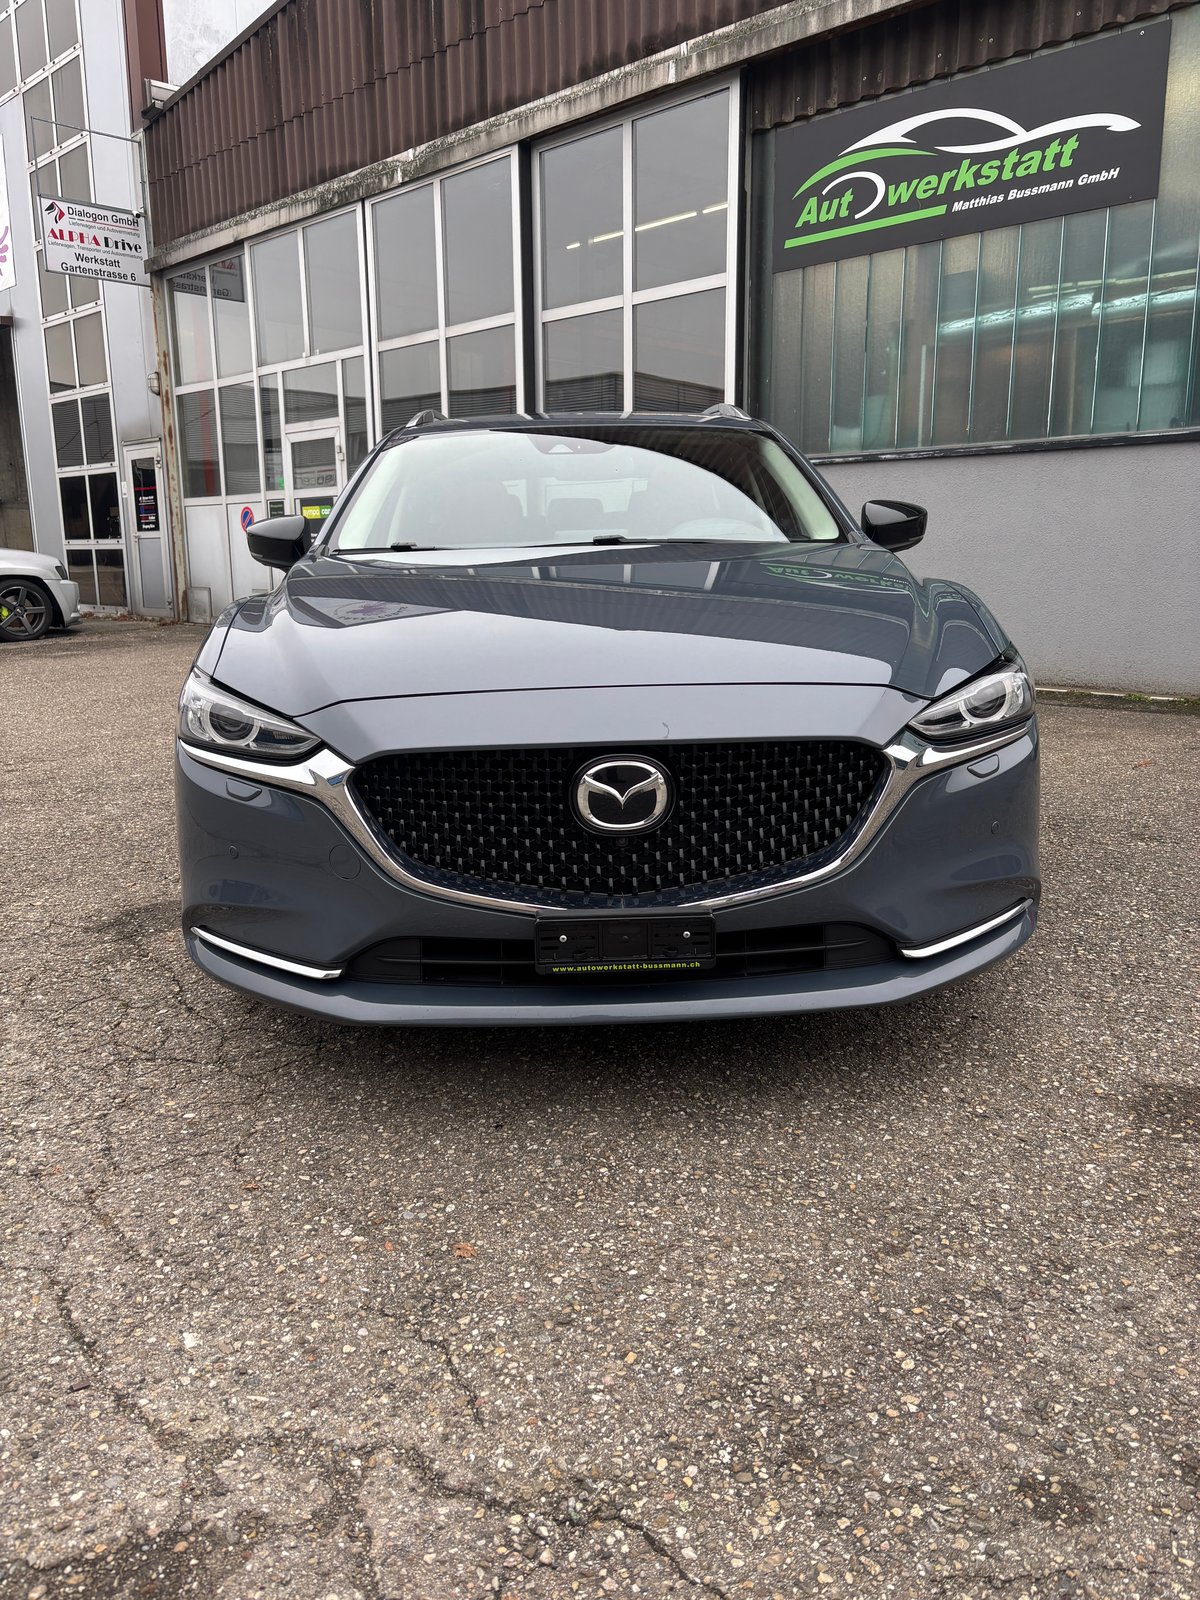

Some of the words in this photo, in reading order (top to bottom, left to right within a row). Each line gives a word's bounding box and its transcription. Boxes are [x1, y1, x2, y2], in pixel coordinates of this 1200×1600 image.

[951, 193, 1005, 213] Matthias
[1007, 179, 1073, 201] Bussmann
[1077, 167, 1121, 187] GmbH
[67, 206, 109, 222] Dialogon
[111, 214, 139, 227] GmbH
[47, 227, 101, 247] ALPHA
[103, 236, 142, 253] Drive
[74, 252, 121, 268] Werkstatt
[60, 262, 128, 281] Gartenstrasse
[130, 272, 137, 282] 6
[552, 961, 700, 972] www.autowerkstatt-bussmann.ch
